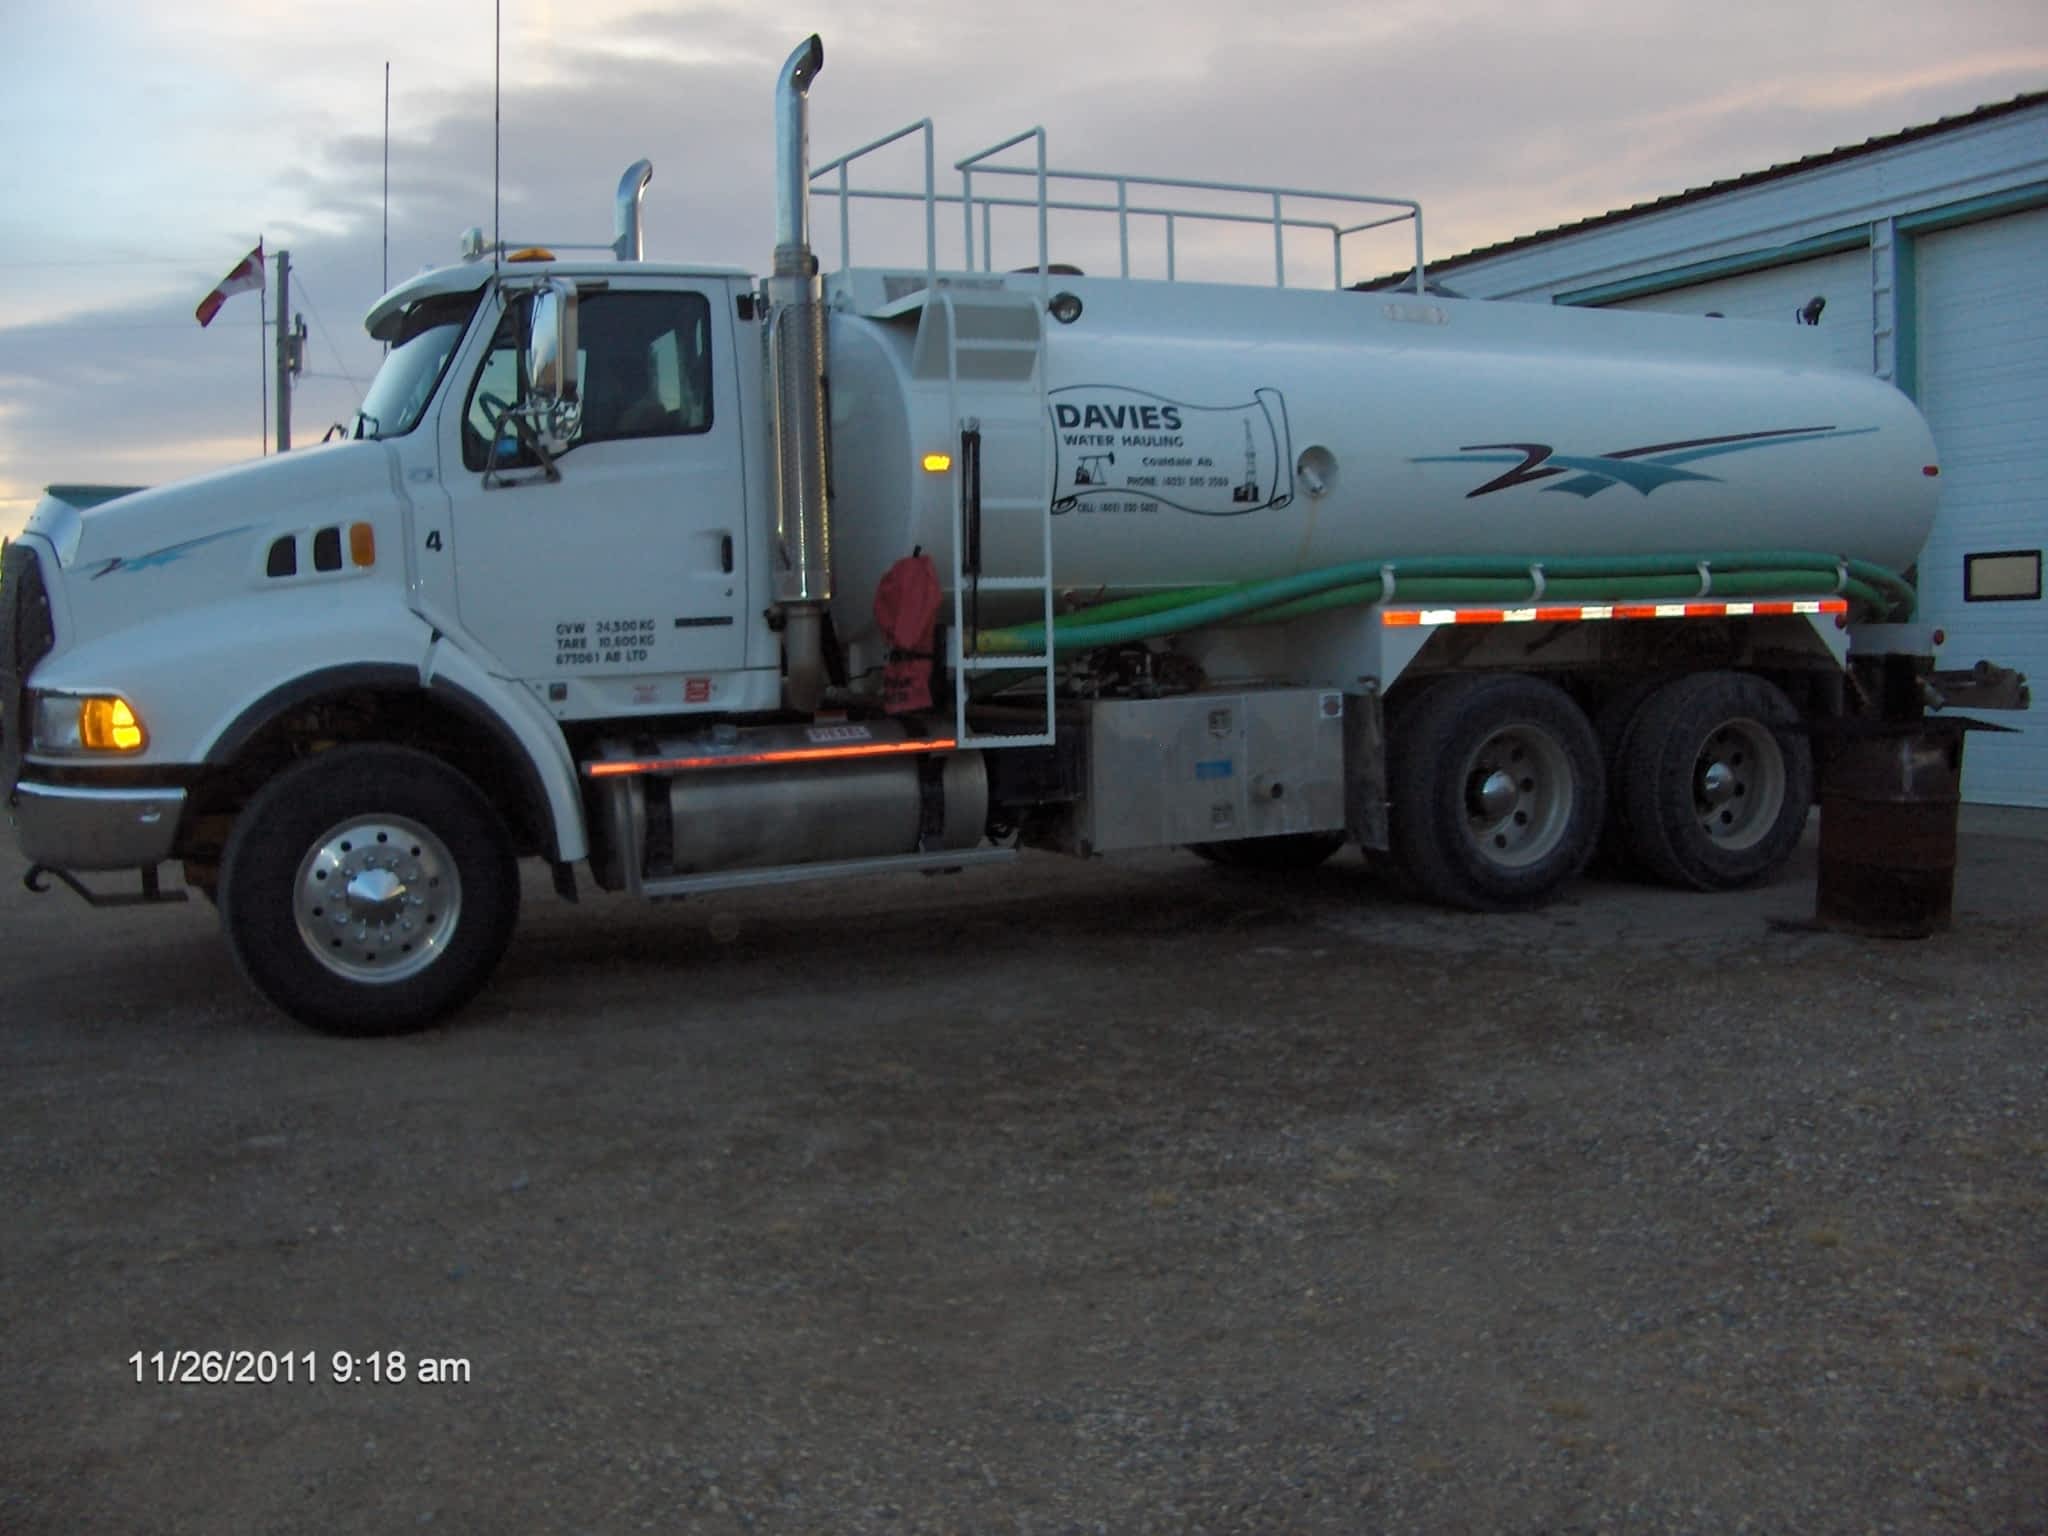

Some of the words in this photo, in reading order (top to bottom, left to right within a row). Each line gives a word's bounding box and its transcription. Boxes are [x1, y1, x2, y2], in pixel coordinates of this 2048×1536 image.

[1056, 404, 1182, 430] DAVIES
[1063, 435, 1115, 447] WATER
[1122, 435, 1184, 447] HAULING
[425, 530, 443, 552] 4
[557, 637, 587, 649] TARE
[626, 649, 648, 662] LTD
